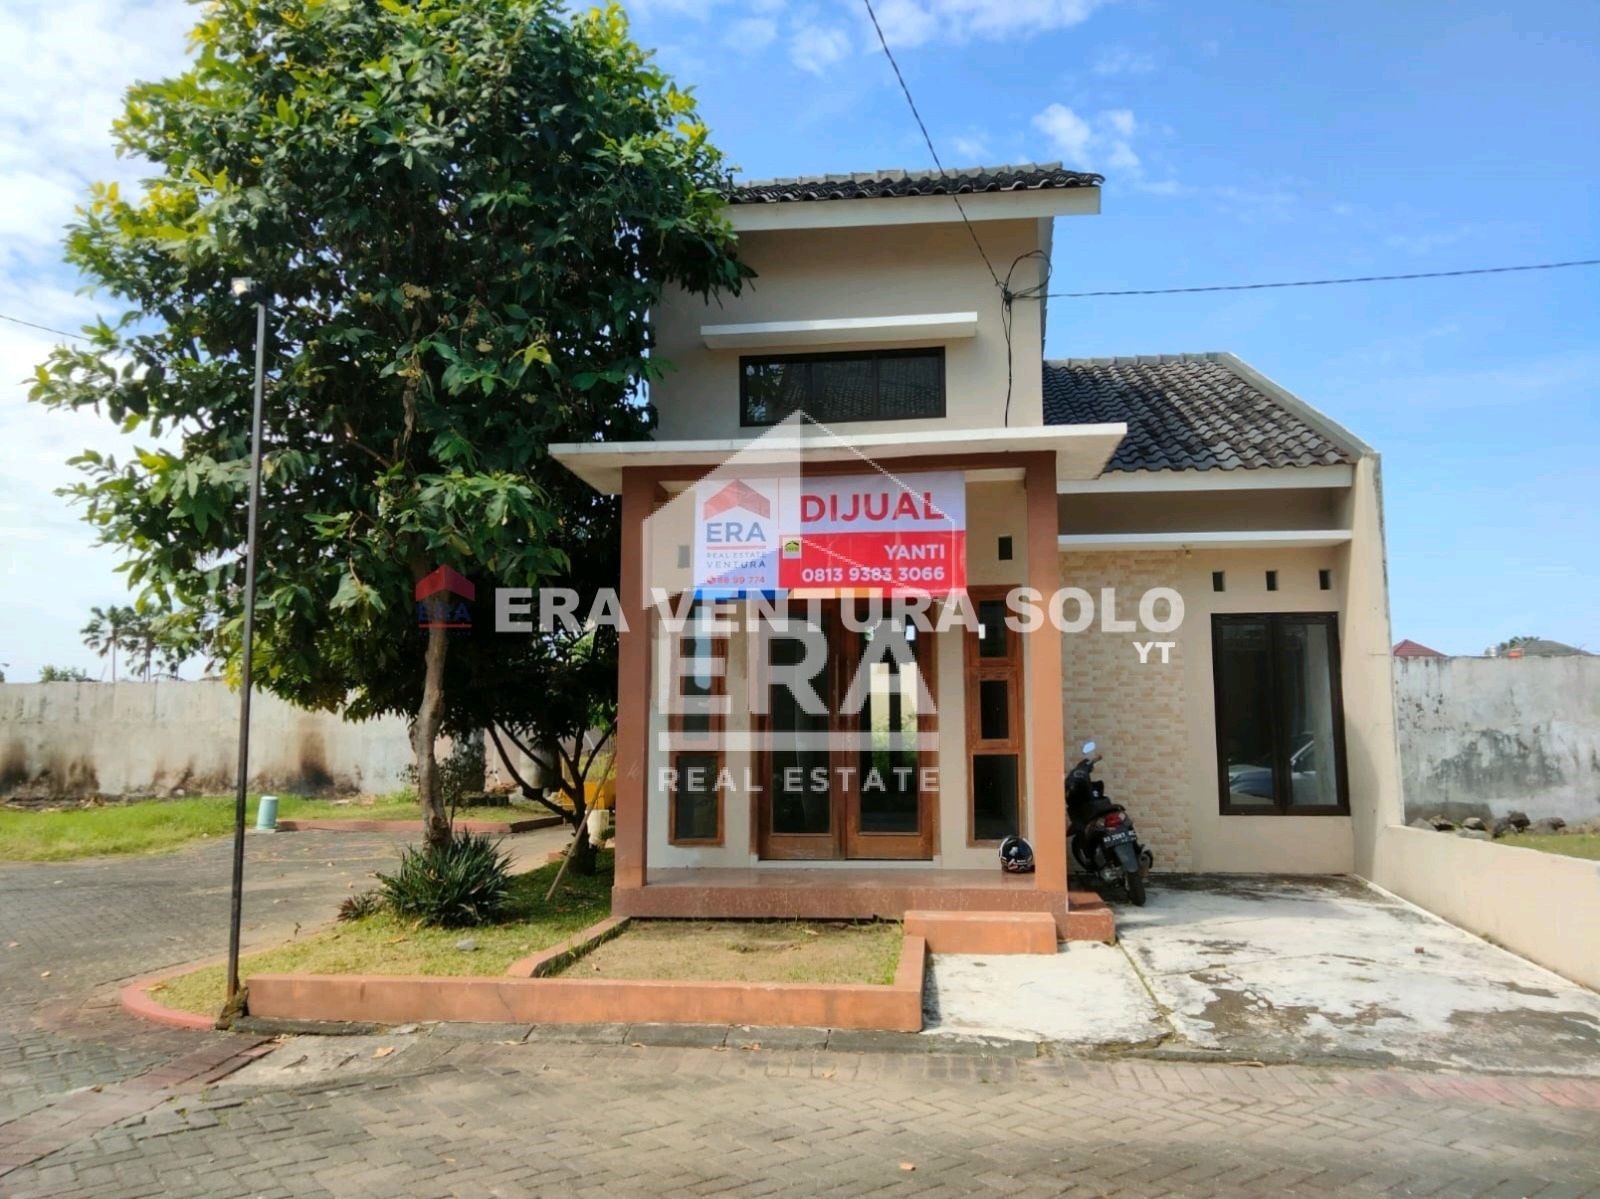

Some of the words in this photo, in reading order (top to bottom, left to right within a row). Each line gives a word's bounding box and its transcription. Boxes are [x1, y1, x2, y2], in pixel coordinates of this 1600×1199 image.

[800, 491, 945, 522] DIJUAL
[706, 522, 766, 543] ERA
[884, 544, 945, 561] YANTI
[706, 560, 766, 569] VENTURA
[801, 567, 843, 582] 0813
[849, 567, 892, 582] 9383
[898, 566, 945, 581] 3066
